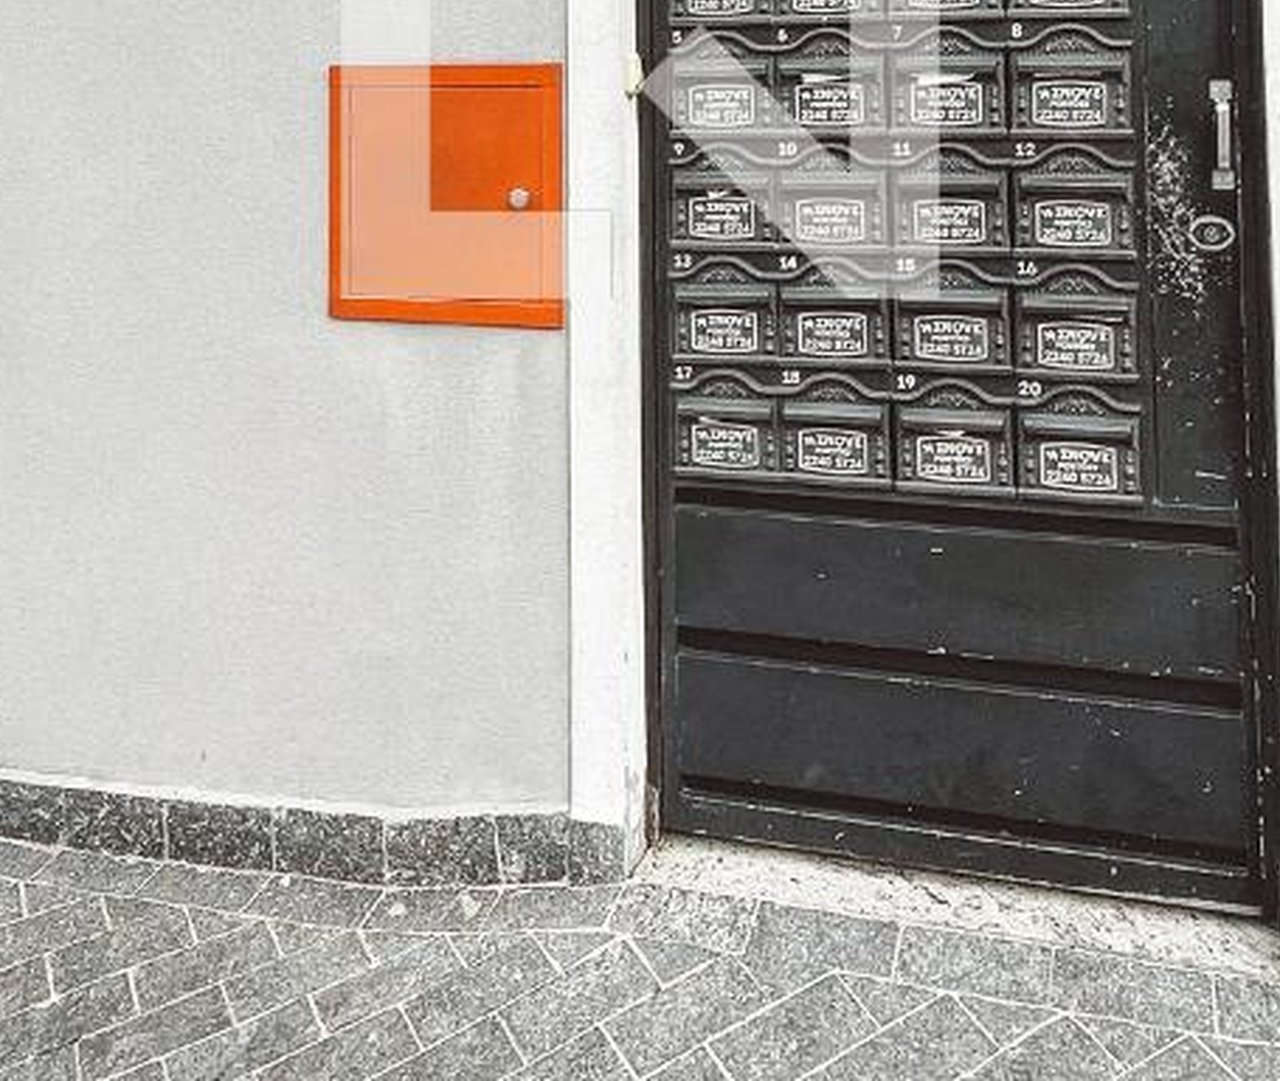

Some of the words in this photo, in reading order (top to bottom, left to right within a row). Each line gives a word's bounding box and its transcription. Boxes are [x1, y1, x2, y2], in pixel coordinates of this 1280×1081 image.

[672, 31, 682, 44] 5
[778, 29, 788, 42] 6
[892, 26, 902, 40] 7
[1011, 23, 1022, 38] 8
[674, 144, 684, 156] 9
[778, 142, 797, 156] 10
[893, 143, 911, 157] 11
[1015, 143, 1036, 157] 12
[780, 256, 797, 270] 14
[896, 258, 915, 272] 15
[675, 366, 693, 379] 17
[897, 375, 915, 389] 19
[1018, 381, 1042, 395] 20
